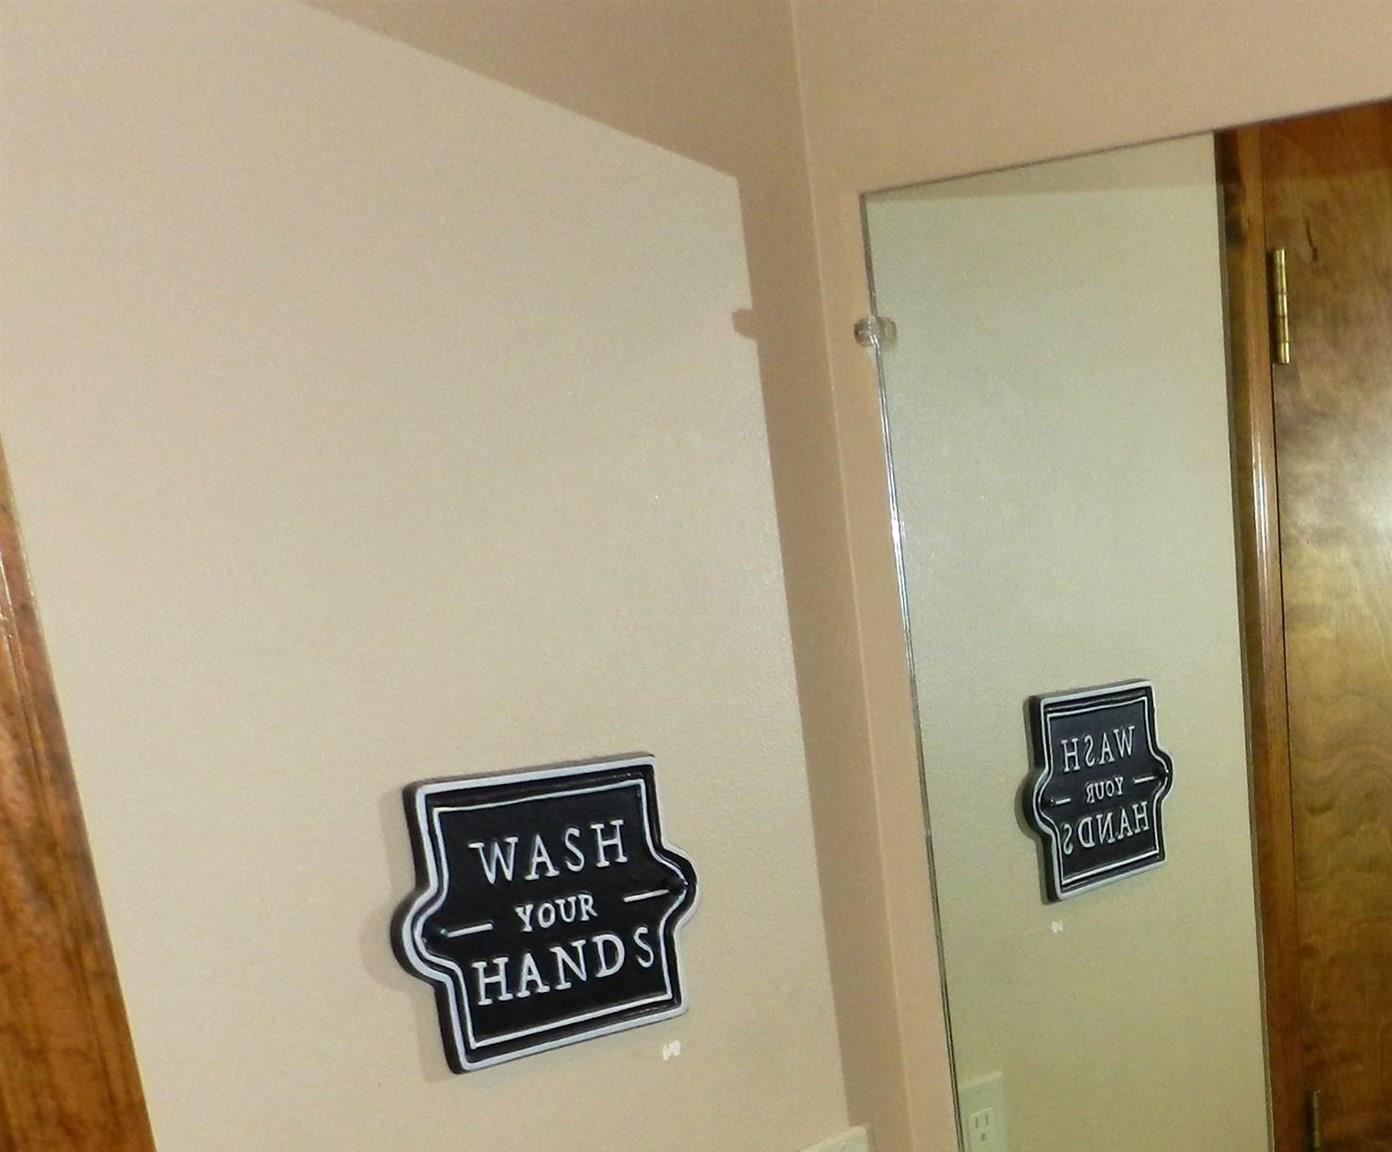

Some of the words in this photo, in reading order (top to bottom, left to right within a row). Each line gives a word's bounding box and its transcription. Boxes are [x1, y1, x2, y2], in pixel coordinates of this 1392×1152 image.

[467, 819, 628, 885] WASH
[513, 893, 598, 933] YOUR
[471, 925, 655, 1006] HANDS
